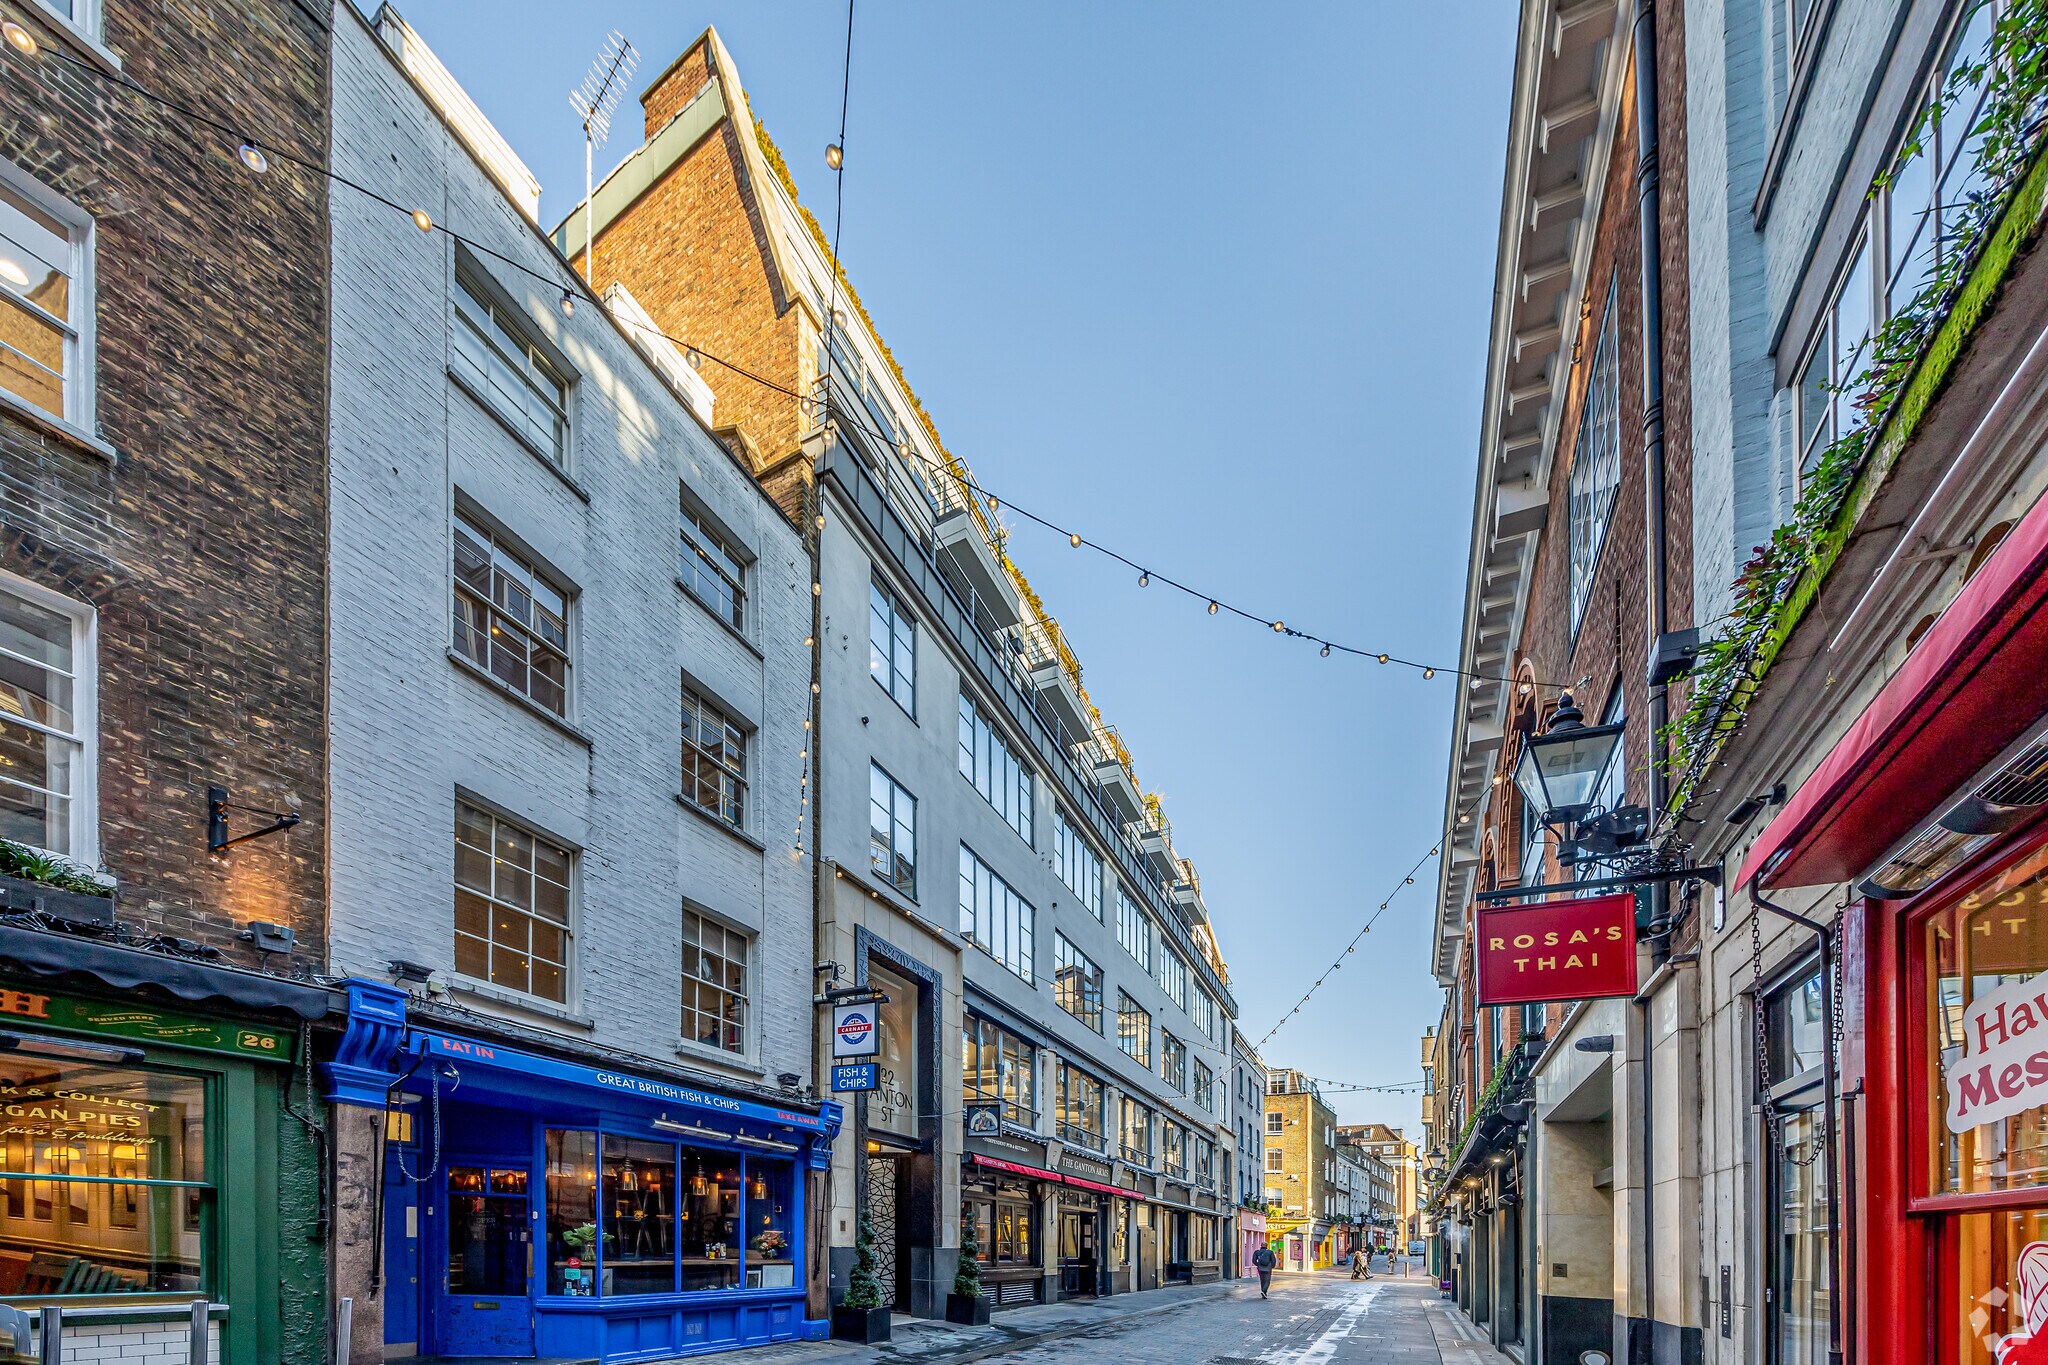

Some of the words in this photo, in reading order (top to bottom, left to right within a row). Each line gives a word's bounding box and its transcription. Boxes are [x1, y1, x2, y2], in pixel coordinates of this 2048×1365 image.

[1489, 926, 1622, 951] ROSA'S
[1513, 953, 1598, 973] THAI
[841, 1025, 869, 1033] CARNABY
[243, 1034, 275, 1049] 26
[442, 1039, 471, 1053] EAT
[475, 1046, 495, 1059] IN
[838, 1067, 859, 1078] FISH
[861, 1066, 869, 1076] &
[880, 1067, 895, 1086] 22
[597, 1073, 635, 1090] GREAT
[638, 1081, 678, 1099] BRITISH
[680, 1090, 702, 1104] FISH
[704, 1094, 712, 1105] &
[713, 1097, 740, 1111] CHIPS
[839, 1077, 867, 1088] CHIPS
[26, 1088, 46, 1096] &
[54, 1090, 160, 1113] COLLECT
[870, 1087, 912, 1110] ANTON
[0, 1103, 68, 1120] GAN
[79, 1111, 141, 1127] PIES
[777, 1111, 797, 1122] TAKE
[798, 1115, 819, 1126] AWAY
[881, 1106, 895, 1123] ST
[70, 1130, 156, 1147] puddings
[1062, 1157, 1073, 1169] THE
[1074, 1161, 1096, 1174] GANTON
[1096, 1168, 1109, 1178] ARMS
